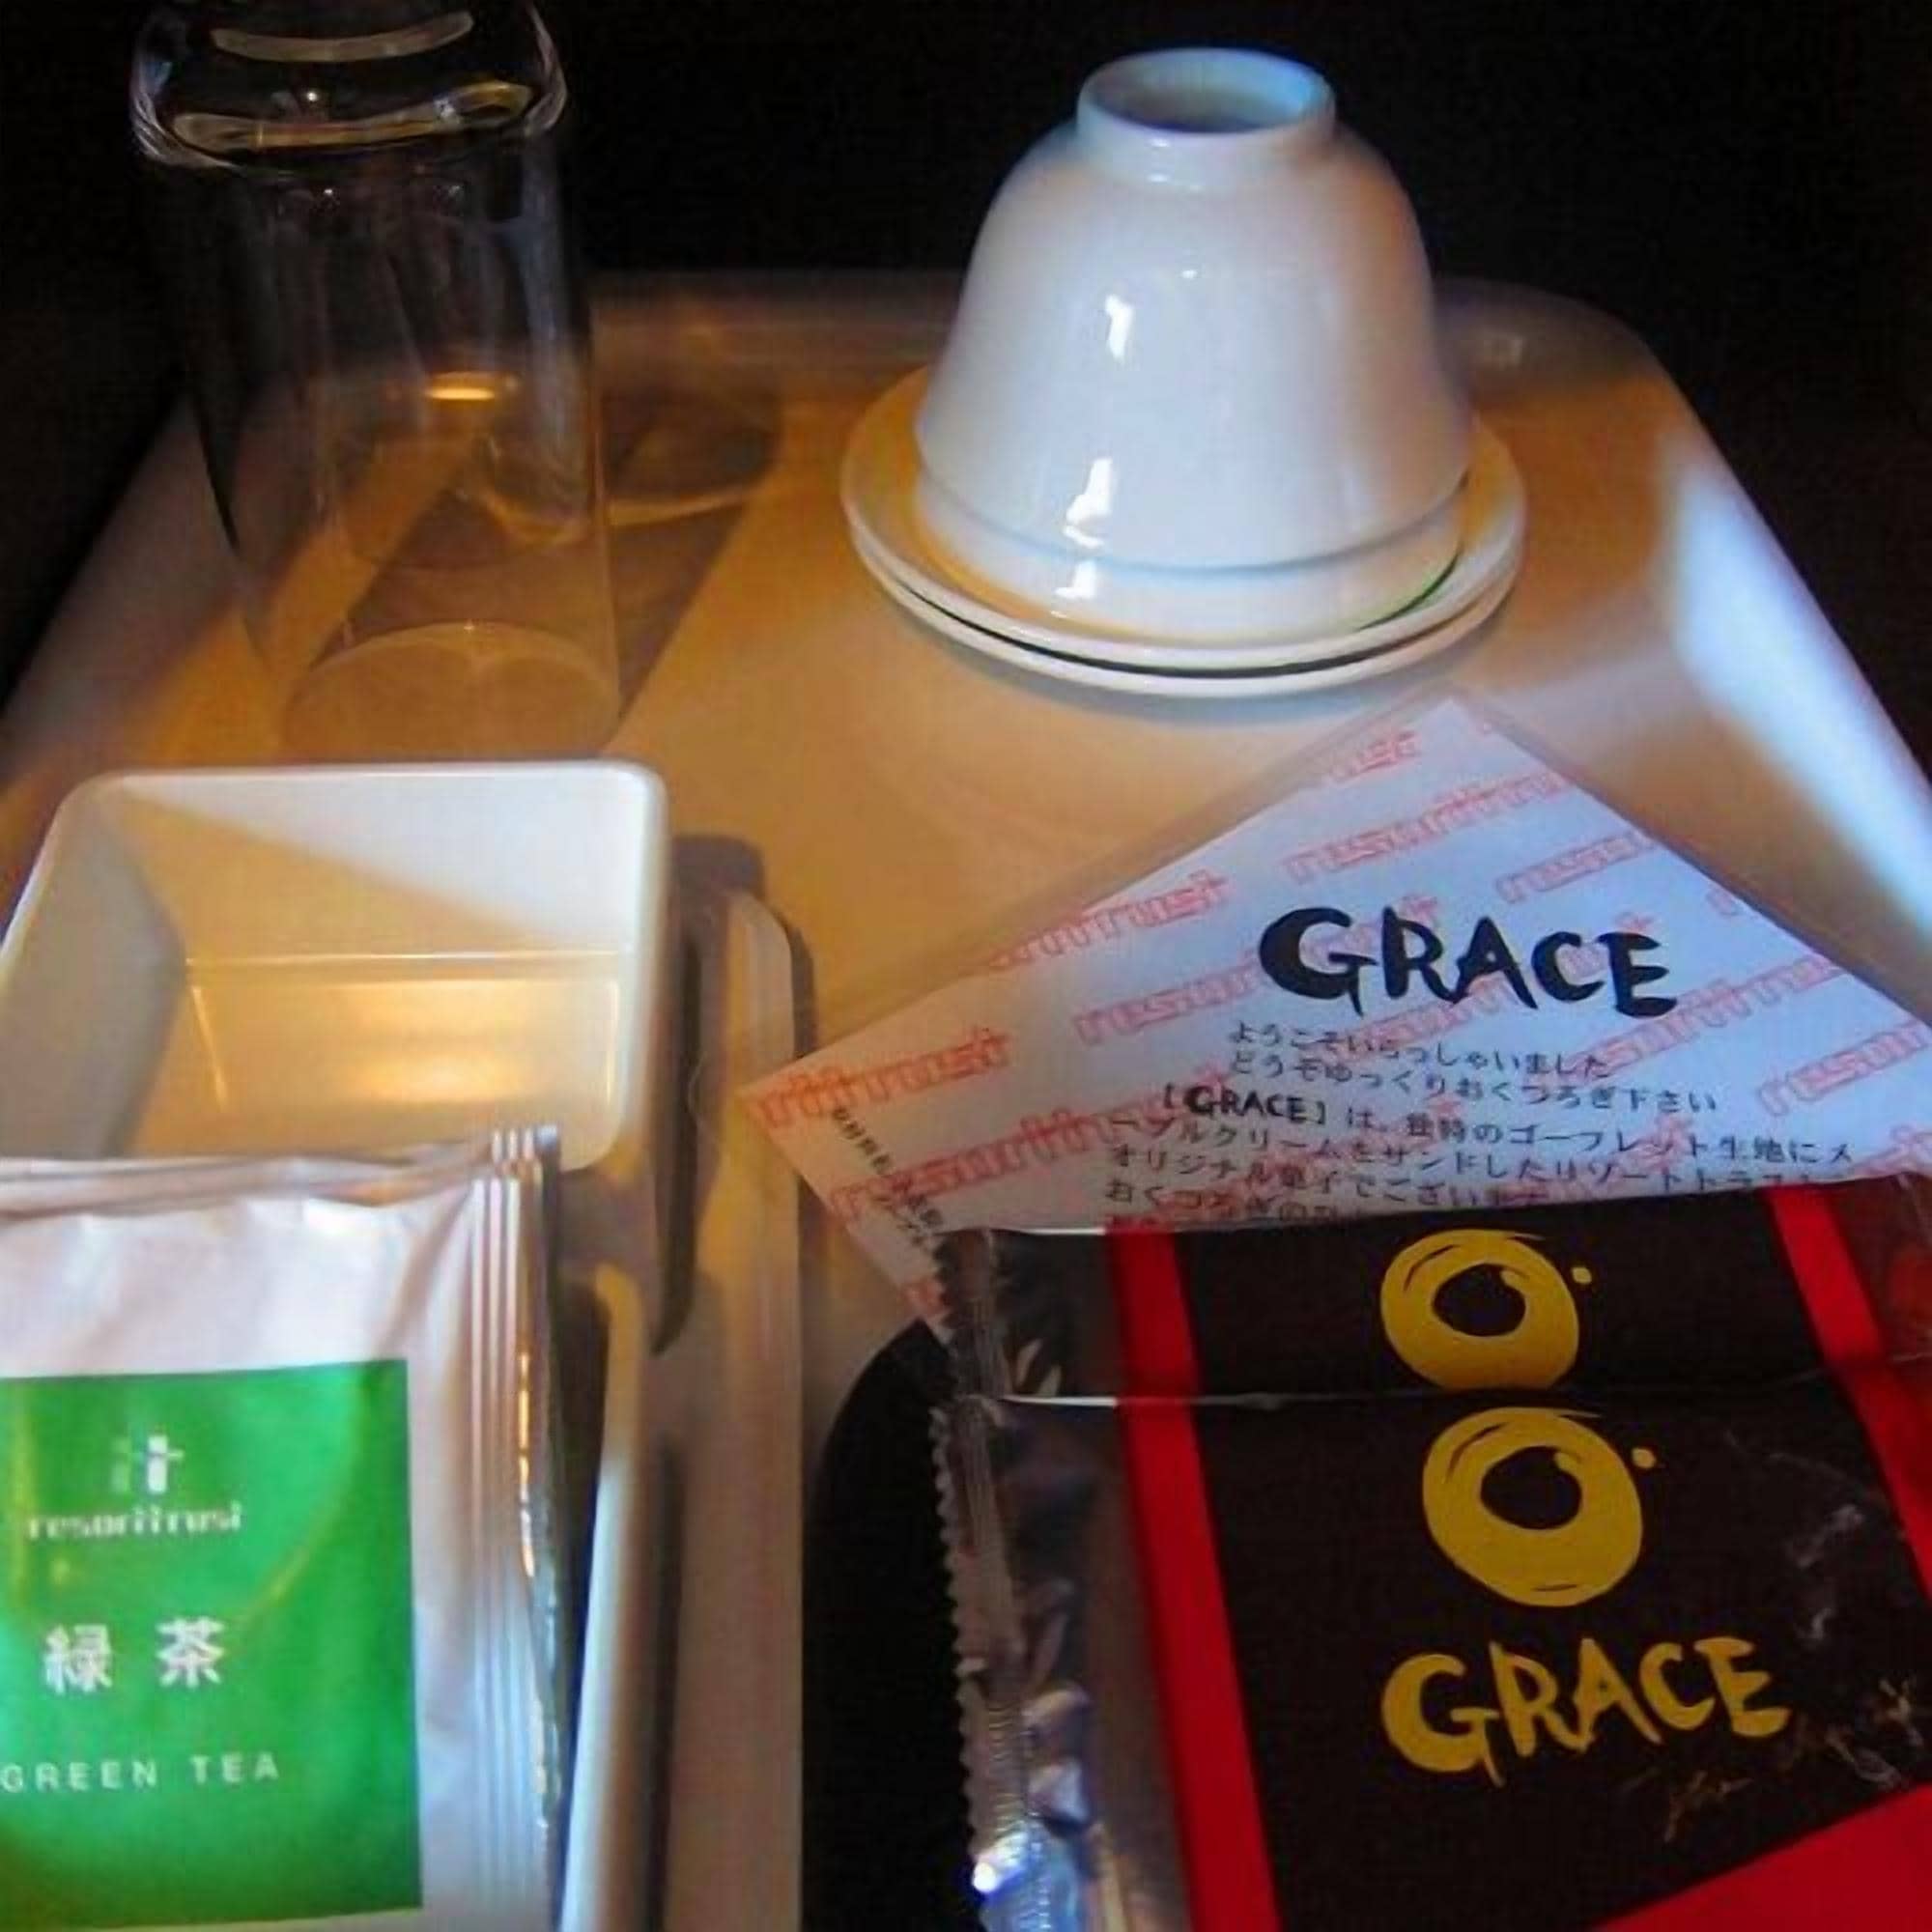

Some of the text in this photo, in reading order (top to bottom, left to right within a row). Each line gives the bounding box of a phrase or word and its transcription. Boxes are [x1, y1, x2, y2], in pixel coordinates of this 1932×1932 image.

[1261, 906, 1677, 1017] GRACE
[43, 1615, 226, 1694] 緑茶
[1380, 1637, 1792, 1788] GRACE
[0, 1750, 280, 1794] GREEN TEA
